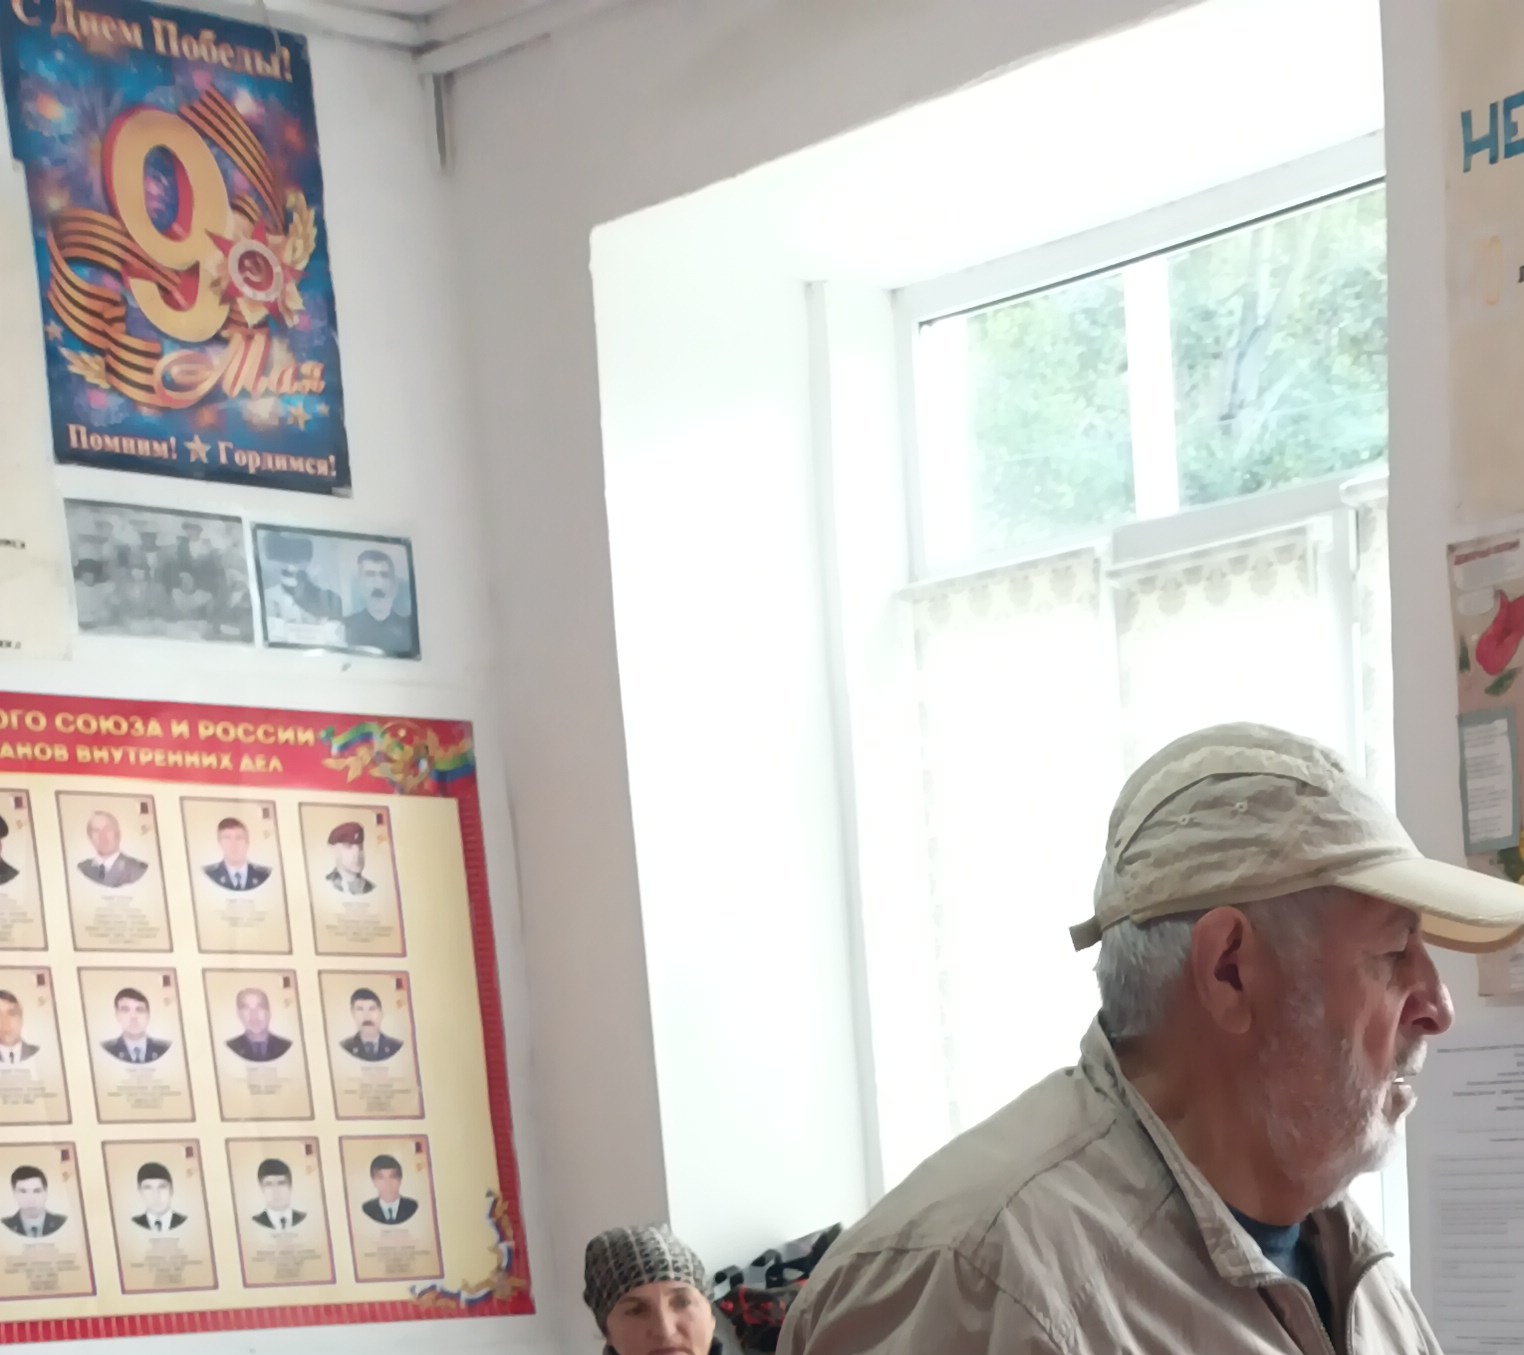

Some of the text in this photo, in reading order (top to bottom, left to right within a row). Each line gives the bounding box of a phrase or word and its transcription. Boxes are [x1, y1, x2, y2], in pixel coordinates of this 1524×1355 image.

[51, 0, 144, 49] Днем
[150, 16, 293, 83] Победы!
[104, 105, 236, 343] 9
[153, 328, 326, 410] Мая
[68, 424, 337, 477] Помним! Гордимся!
[55, 712, 163, 738] СОЮЗА
[171, 719, 190, 739] И
[198, 721, 316, 746] РОССИИ
[76, 744, 234, 771] ВНУТРЕННИХ
[239, 754, 284, 772] ДЕЛ
